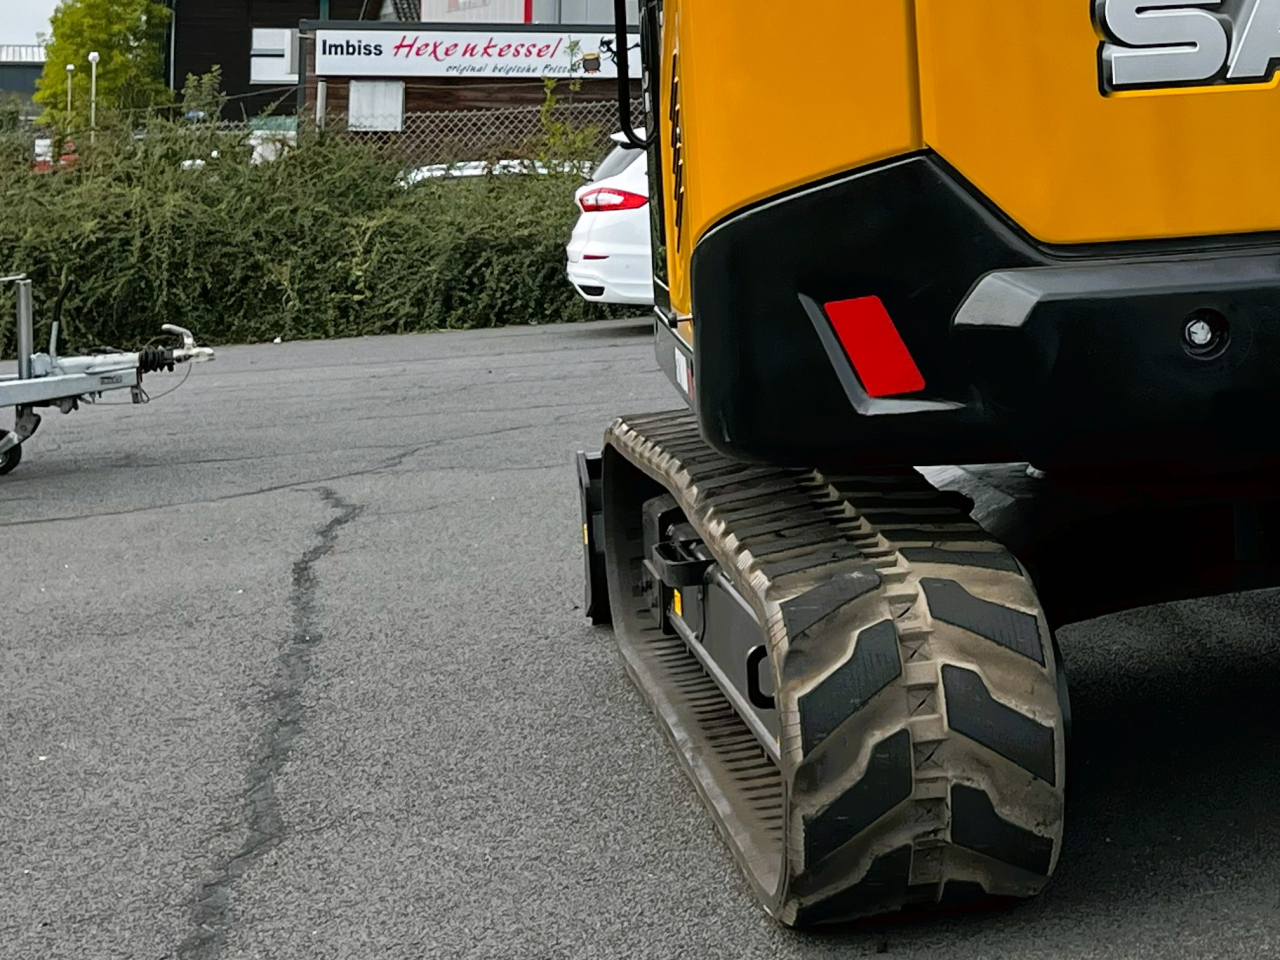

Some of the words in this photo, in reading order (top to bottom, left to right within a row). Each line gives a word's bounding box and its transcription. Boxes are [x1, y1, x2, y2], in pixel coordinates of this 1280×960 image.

[322, 39, 383, 56] Imbiss
[393, 35, 563, 62] Hexenkessel
[445, 63, 488, 75] original
